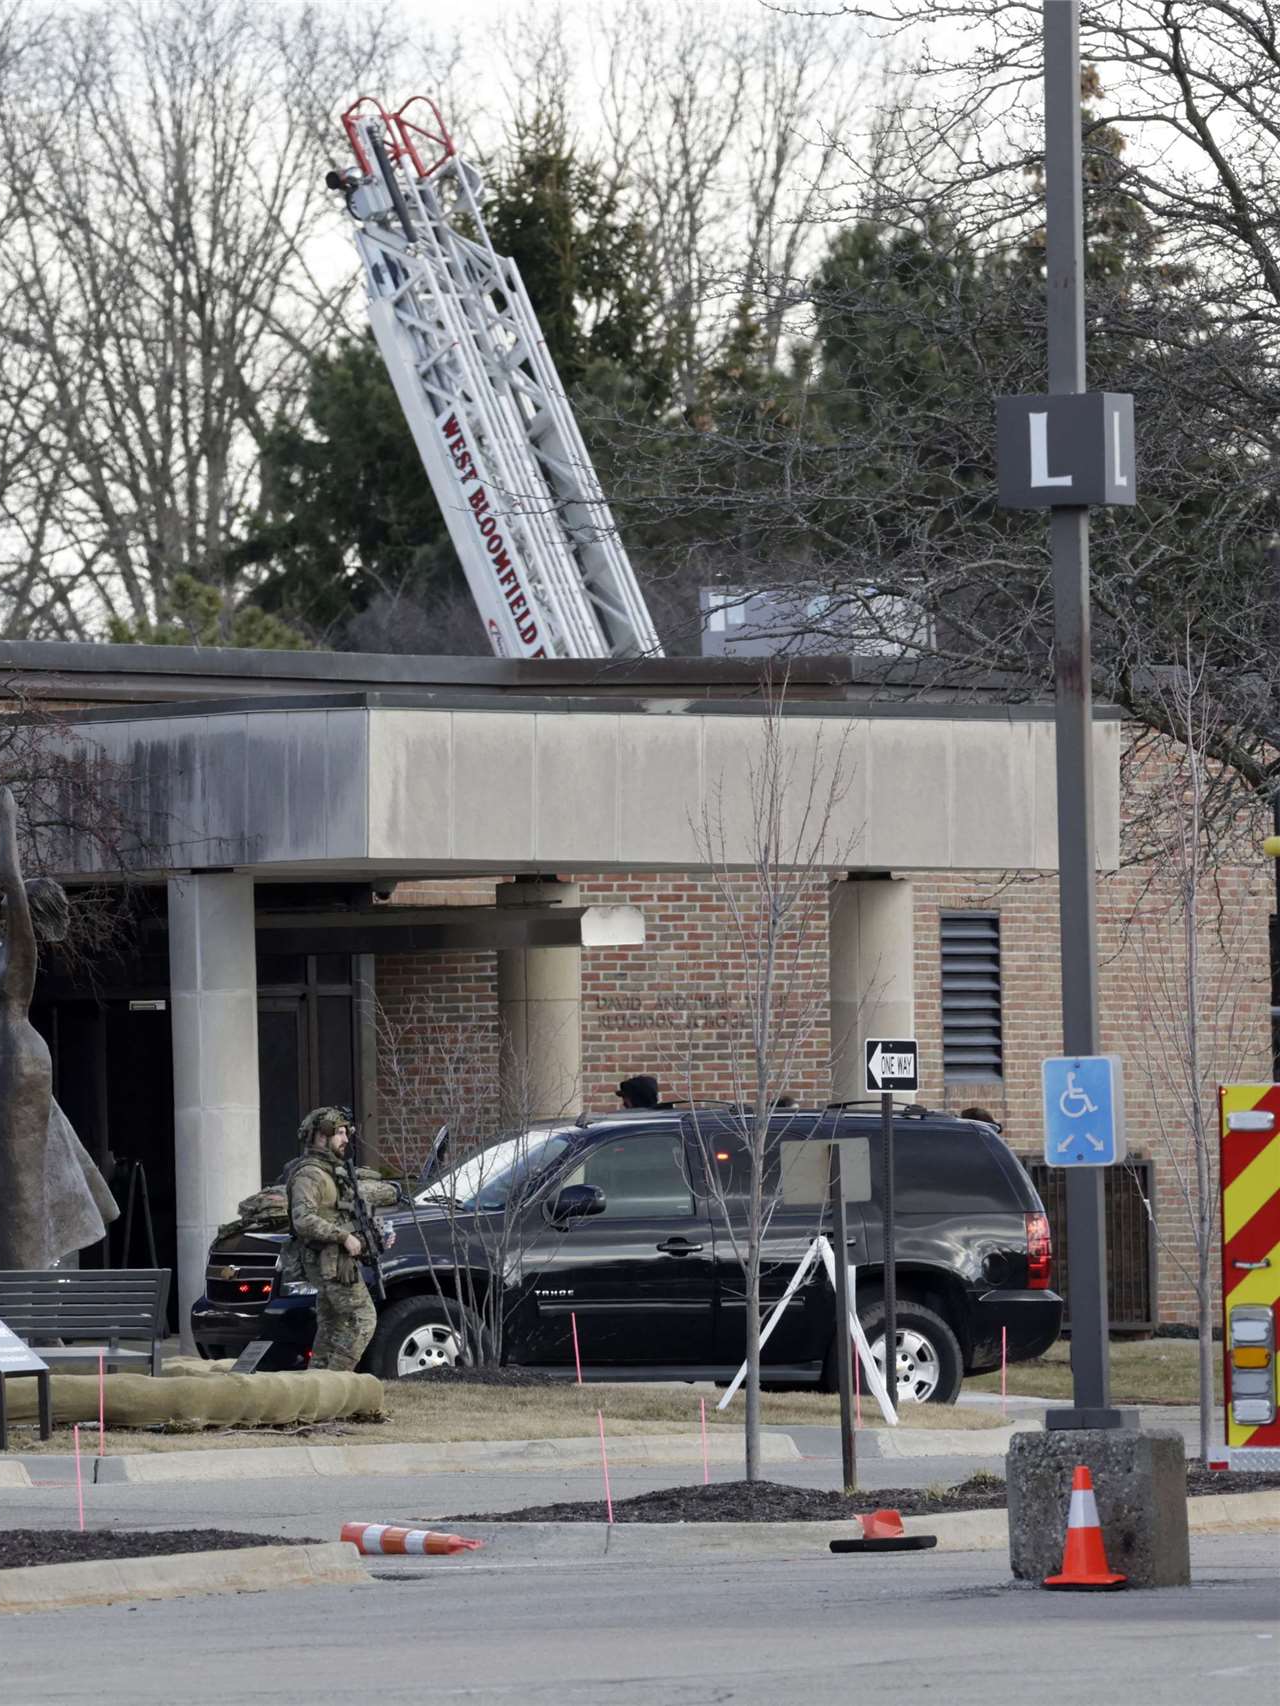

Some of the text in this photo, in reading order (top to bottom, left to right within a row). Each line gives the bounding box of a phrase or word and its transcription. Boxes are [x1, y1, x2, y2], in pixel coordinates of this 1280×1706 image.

[1028, 411, 1073, 488] L
[1113, 411, 1128, 487] L
[441, 412, 538, 645] WEST BLOOMFIELD
[596, 995, 641, 1011] DAVID
[655, 993, 687, 1011] AND
[881, 1055, 913, 1076] ONE WAY
[534, 1289, 575, 1297] TAHOE
